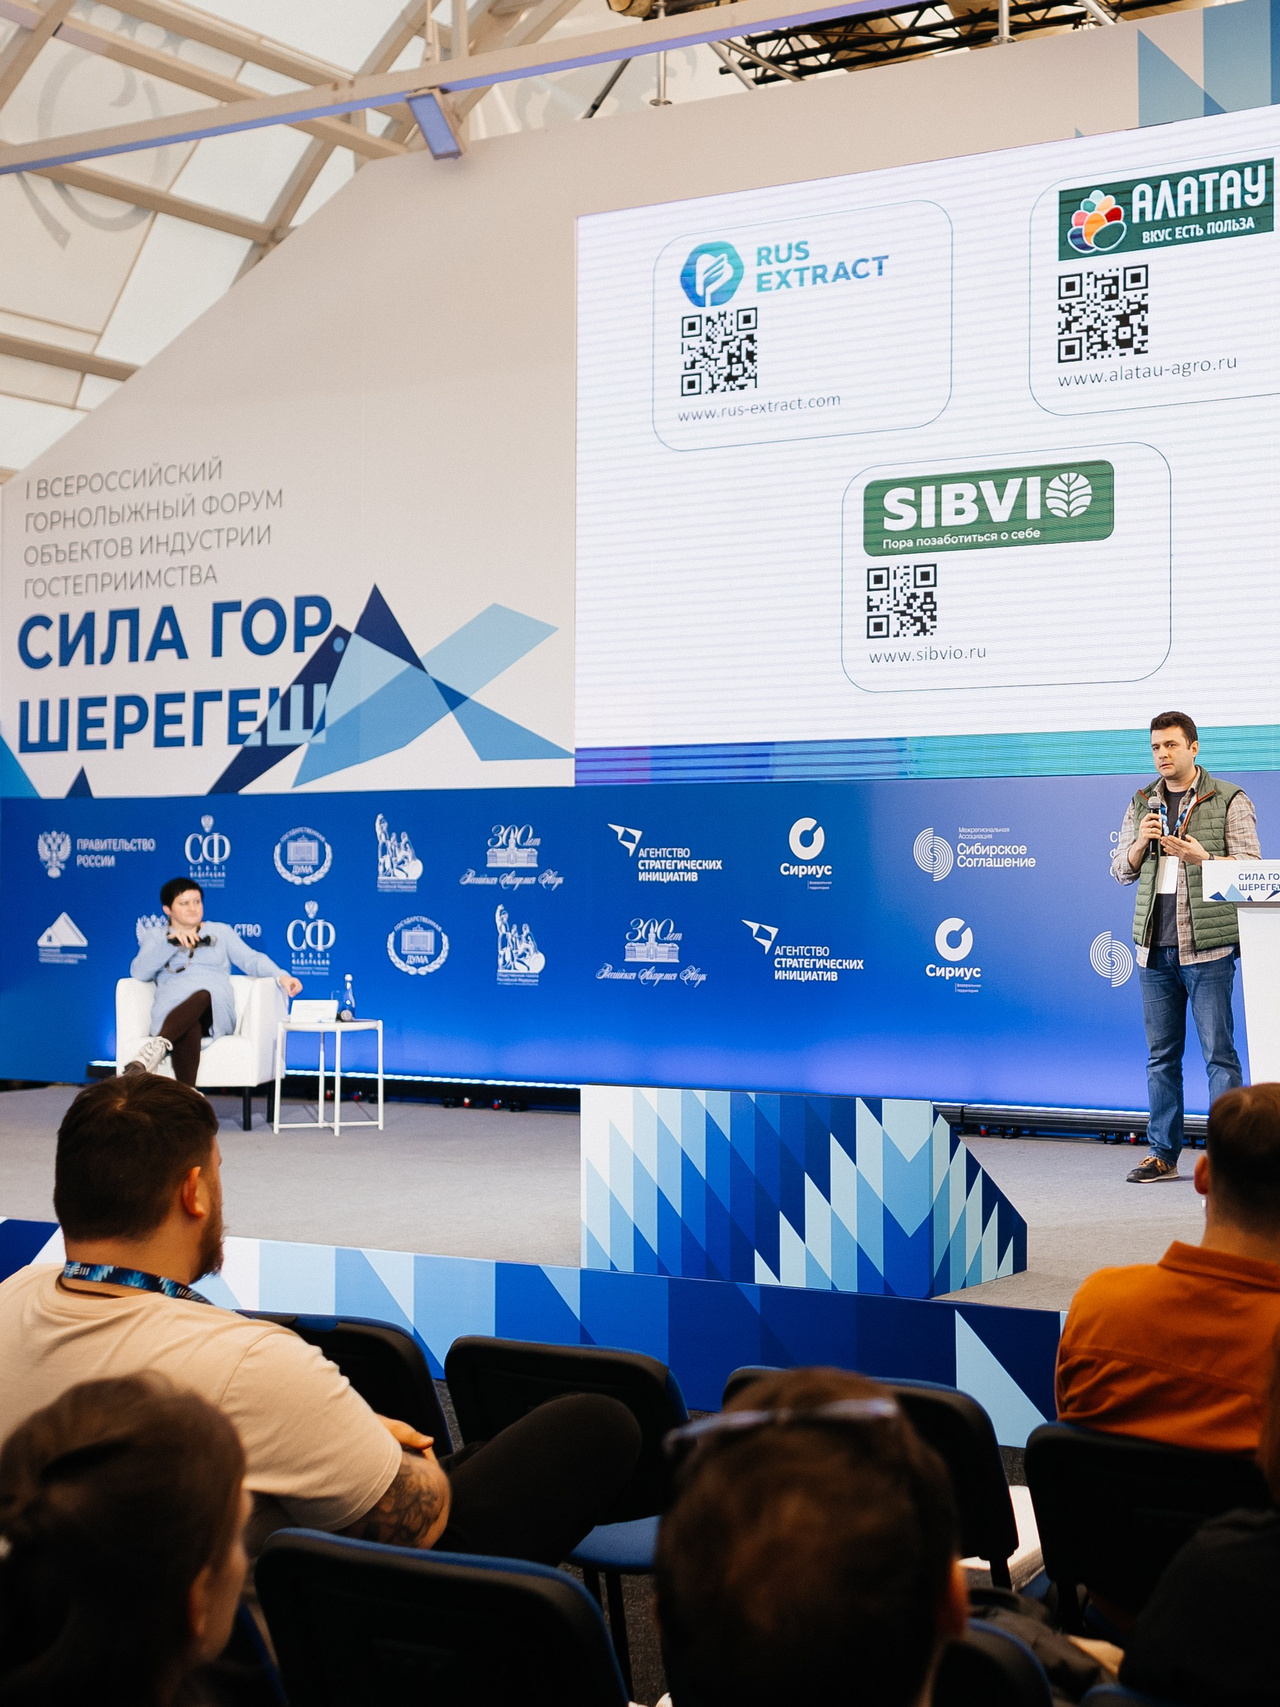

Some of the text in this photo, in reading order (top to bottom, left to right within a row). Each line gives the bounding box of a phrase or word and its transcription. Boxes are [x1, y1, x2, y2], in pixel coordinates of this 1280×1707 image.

[1131, 164, 1266, 223] АЛАТАУ
[1142, 216, 1255, 244] ВКУС ЕСТЬ ПОЛЬЗА
[756, 240, 810, 267] RUS
[756, 255, 890, 293] EXTRACT
[1058, 357, 1238, 387] www.alatau-agro.ru
[677, 395, 841, 422] www.rus-extract.com
[36, 454, 223, 501] ВСЕРОССИЙСКИЙ
[24, 487, 284, 533] ГОРНОЛЫЖНЫЙ ФОРУМ
[23, 524, 272, 567] ОБЪЕКТОВ ИНДУСТРИИ
[883, 527, 1041, 551] Пора позаботиться о себе
[24, 563, 218, 600] ГОСТЕПРИИМСТВА
[17, 605, 189, 670] СИЛА
[868, 645, 987, 664] www.sibvio.ru
[18, 682, 328, 754] ШЕРЕГЕШ
[76, 837, 156, 852] ПРАВИТЕЛЬСТВО
[184, 832, 232, 865] СФ
[638, 847, 691, 859] АГЕНТСТВО
[957, 842, 1027, 857] Сибирское
[76, 853, 116, 868] РОССИИ
[637, 859, 723, 870] СТРАТЕГИЧЕСКИХ
[780, 863, 833, 879] Сириус
[956, 855, 1037, 868] Соглашение
[638, 871, 699, 884] ИНИЦИАТИВ
[1238, 872, 1266, 881] СИЛА
[286, 918, 336, 952] СФ
[406, 954, 429, 965] ДУМА
[774, 945, 830, 957] АГЕНТСТВО
[774, 958, 864, 971] СТРАТЕГИЧЕСКИХ
[925, 963, 981, 981] Сириус
[774, 970, 839, 983] ИНИЦИАТИВ
